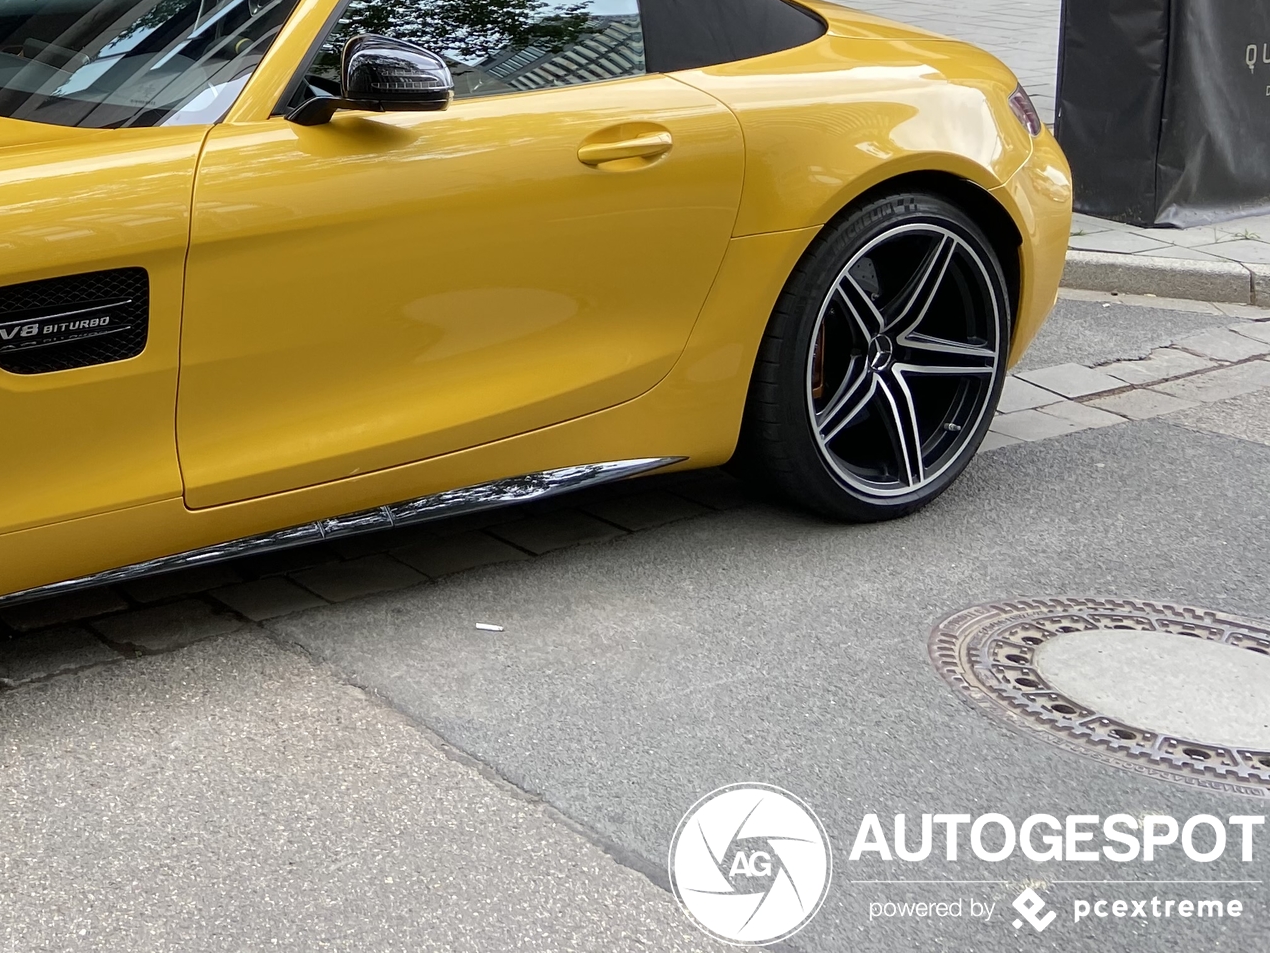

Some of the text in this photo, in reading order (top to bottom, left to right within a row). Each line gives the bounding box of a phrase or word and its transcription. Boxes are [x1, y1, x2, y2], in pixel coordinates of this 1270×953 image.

[834, 203, 893, 252] MICHELIN
[0, 316, 110, 340] V8 BITURBO
